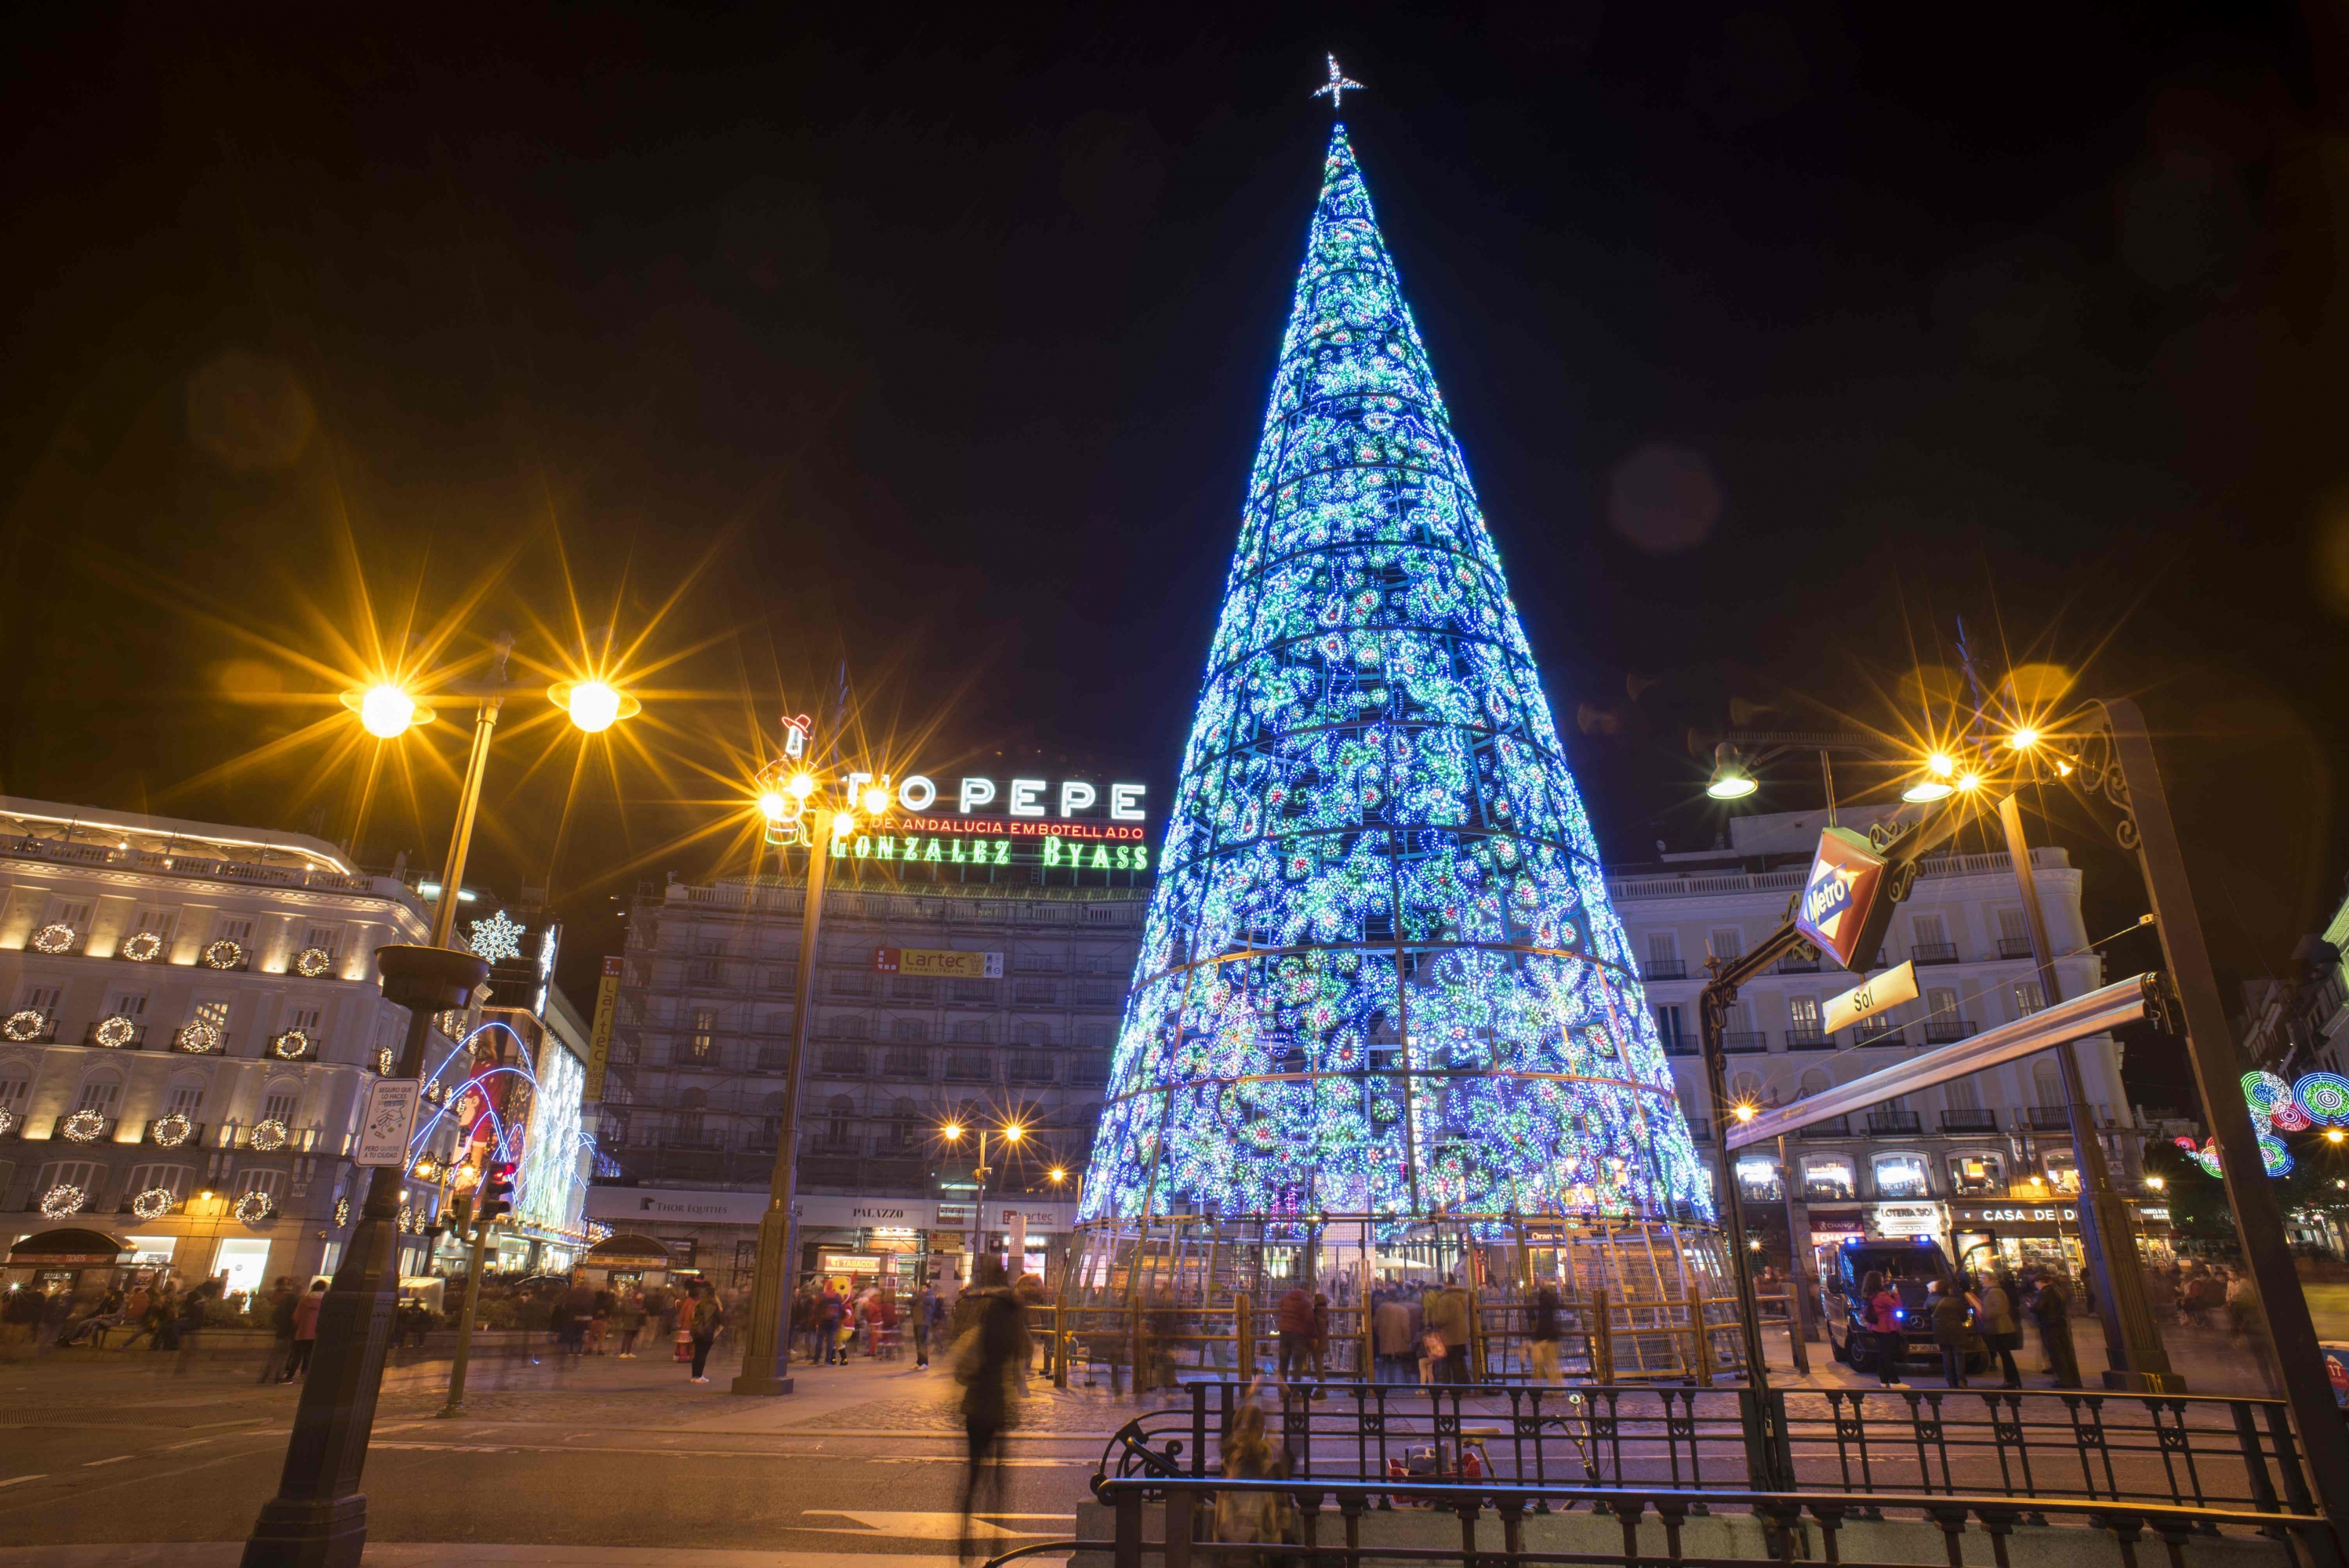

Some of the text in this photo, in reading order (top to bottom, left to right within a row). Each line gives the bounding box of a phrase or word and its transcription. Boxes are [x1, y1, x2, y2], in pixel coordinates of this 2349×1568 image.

[960, 777, 1146, 820] PEPE
[872, 817, 894, 829] DE
[903, 819, 1004, 834] ANDALUCIA
[1011, 823, 1144, 839] EMBOTELLADO
[830, 834, 1148, 869] GONZALEZ BYASS
[1807, 880, 1845, 921] Metro
[906, 952, 964, 967] Lartec
[1853, 986, 1874, 1011] Sol
[594, 980, 612, 1061] Lartec
[657, 1202, 728, 1214] THOR EQUITIES
[853, 1208, 903, 1218] PALAZZO
[1983, 1210, 2025, 1221] CASA
[2035, 1210, 2056, 1221] DE
[1531, 1232, 1563, 1240] Orane
[2329, 1364, 2341, 1377] 17
